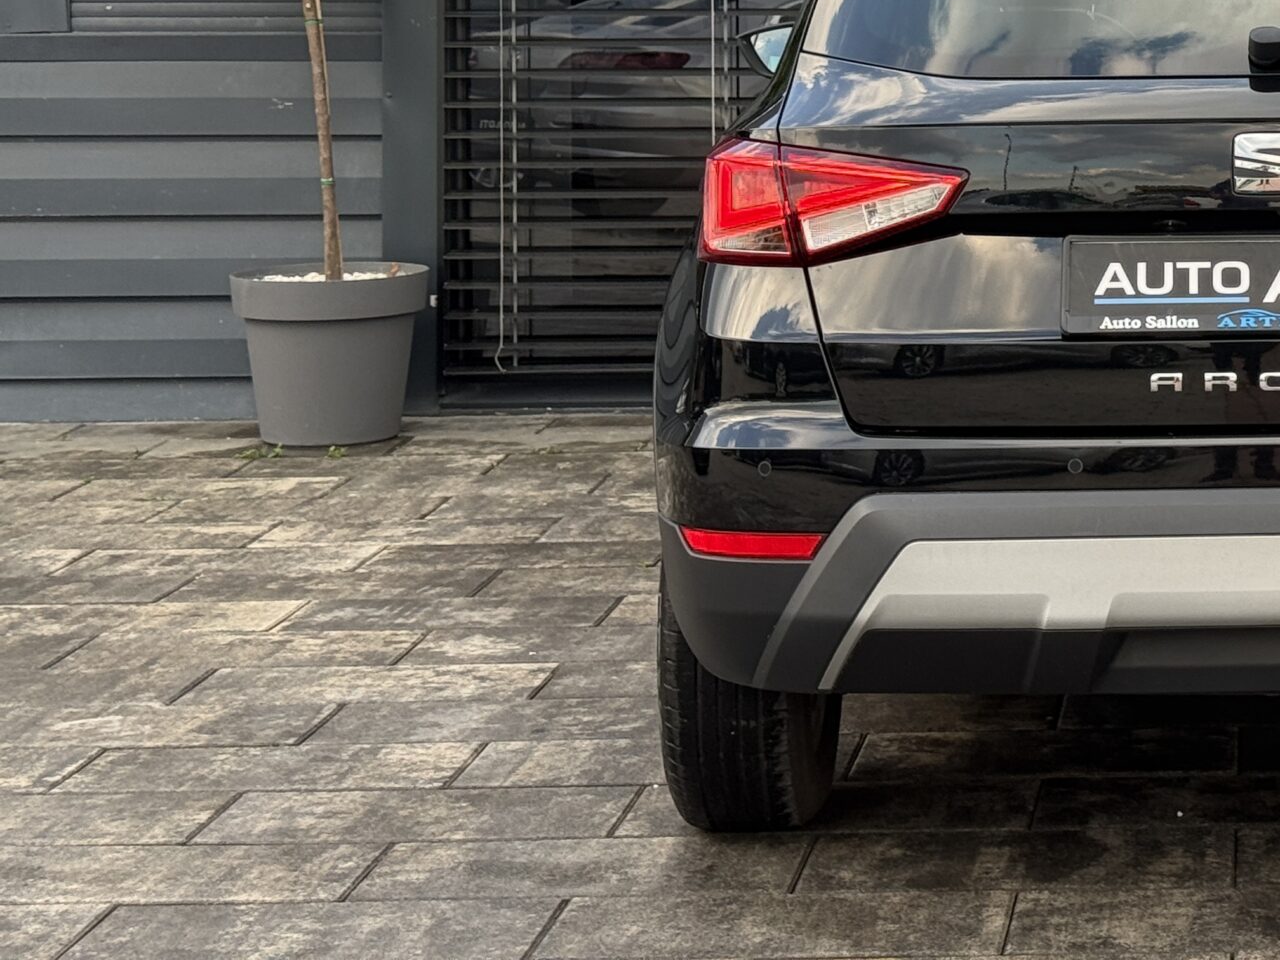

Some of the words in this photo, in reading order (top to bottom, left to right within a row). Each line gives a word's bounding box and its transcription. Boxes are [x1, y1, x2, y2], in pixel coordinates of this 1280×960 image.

[1094, 260, 1250, 296] AUTO
[1099, 315, 1142, 330] Auto
[1145, 314, 1200, 330] Sallon
